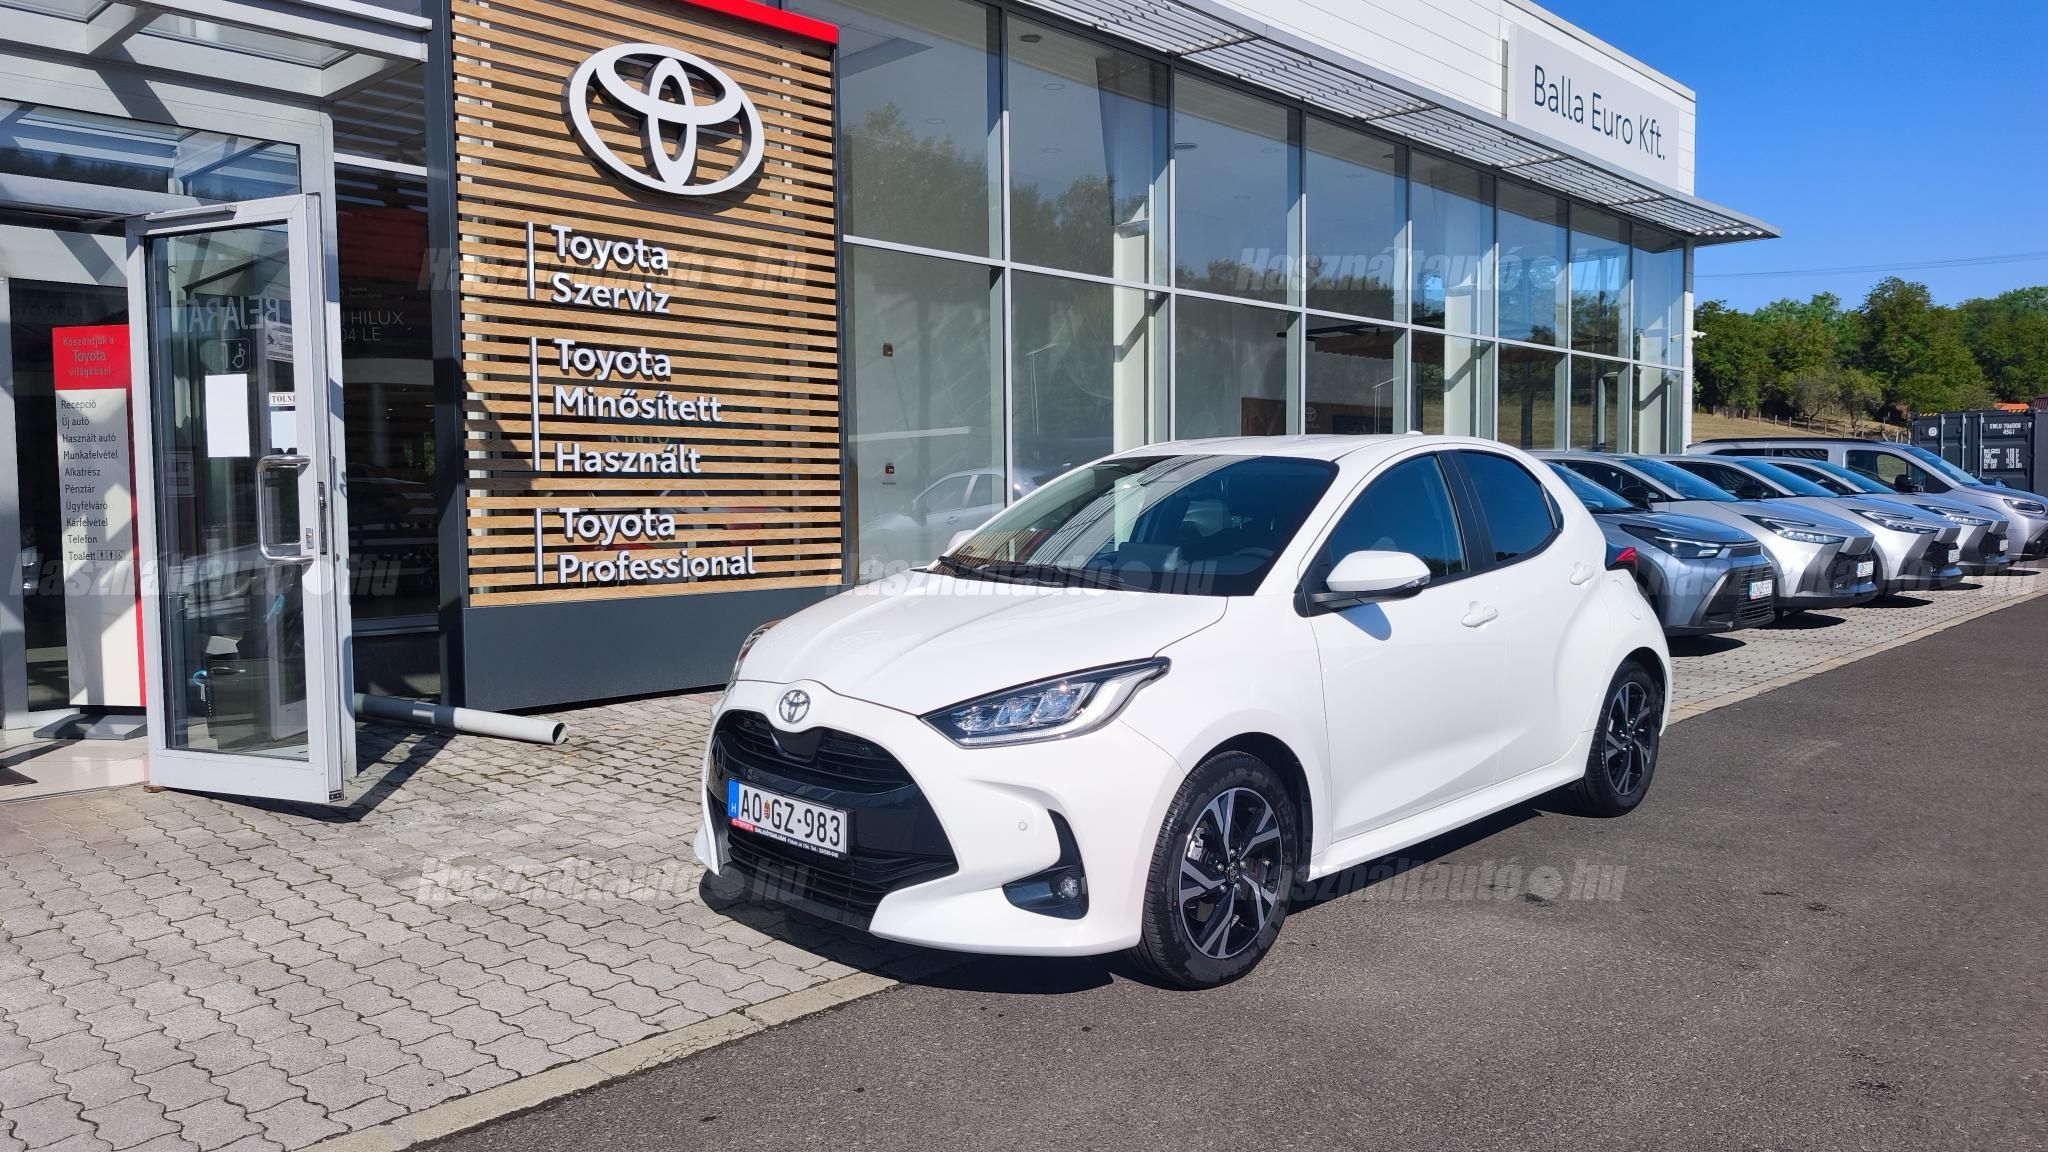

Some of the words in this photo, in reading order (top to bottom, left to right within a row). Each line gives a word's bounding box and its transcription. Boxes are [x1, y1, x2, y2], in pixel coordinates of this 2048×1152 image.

[1534, 64, 1584, 125] Balla
[1591, 92, 1633, 145] Euro
[1639, 114, 1666, 161] Kft.
[550, 224, 669, 273] Toyota
[550, 273, 671, 314] Szerviz
[351, 311, 405, 326] HILUX
[363, 327, 381, 341] LE
[72, 349, 106, 363] Toyota
[553, 338, 672, 380] Toyota
[61, 399, 97, 411] Recepció
[553, 385, 723, 423] Minősített
[62, 415, 70, 430] Új
[72, 416, 90, 426] autó
[62, 433, 97, 443] Használt
[98, 432, 117, 442] autó
[63, 449, 118, 460] Munkafelvétel
[554, 442, 702, 475] Használt
[65, 467, 101, 477] Alkatrész
[65, 484, 96, 494] Pénztár
[559, 507, 676, 546] Toyota
[68, 534, 98, 544] Telefon
[68, 551, 97, 561] Toalett
[558, 547, 756, 584] Professional
[731, 802, 737, 814] H
